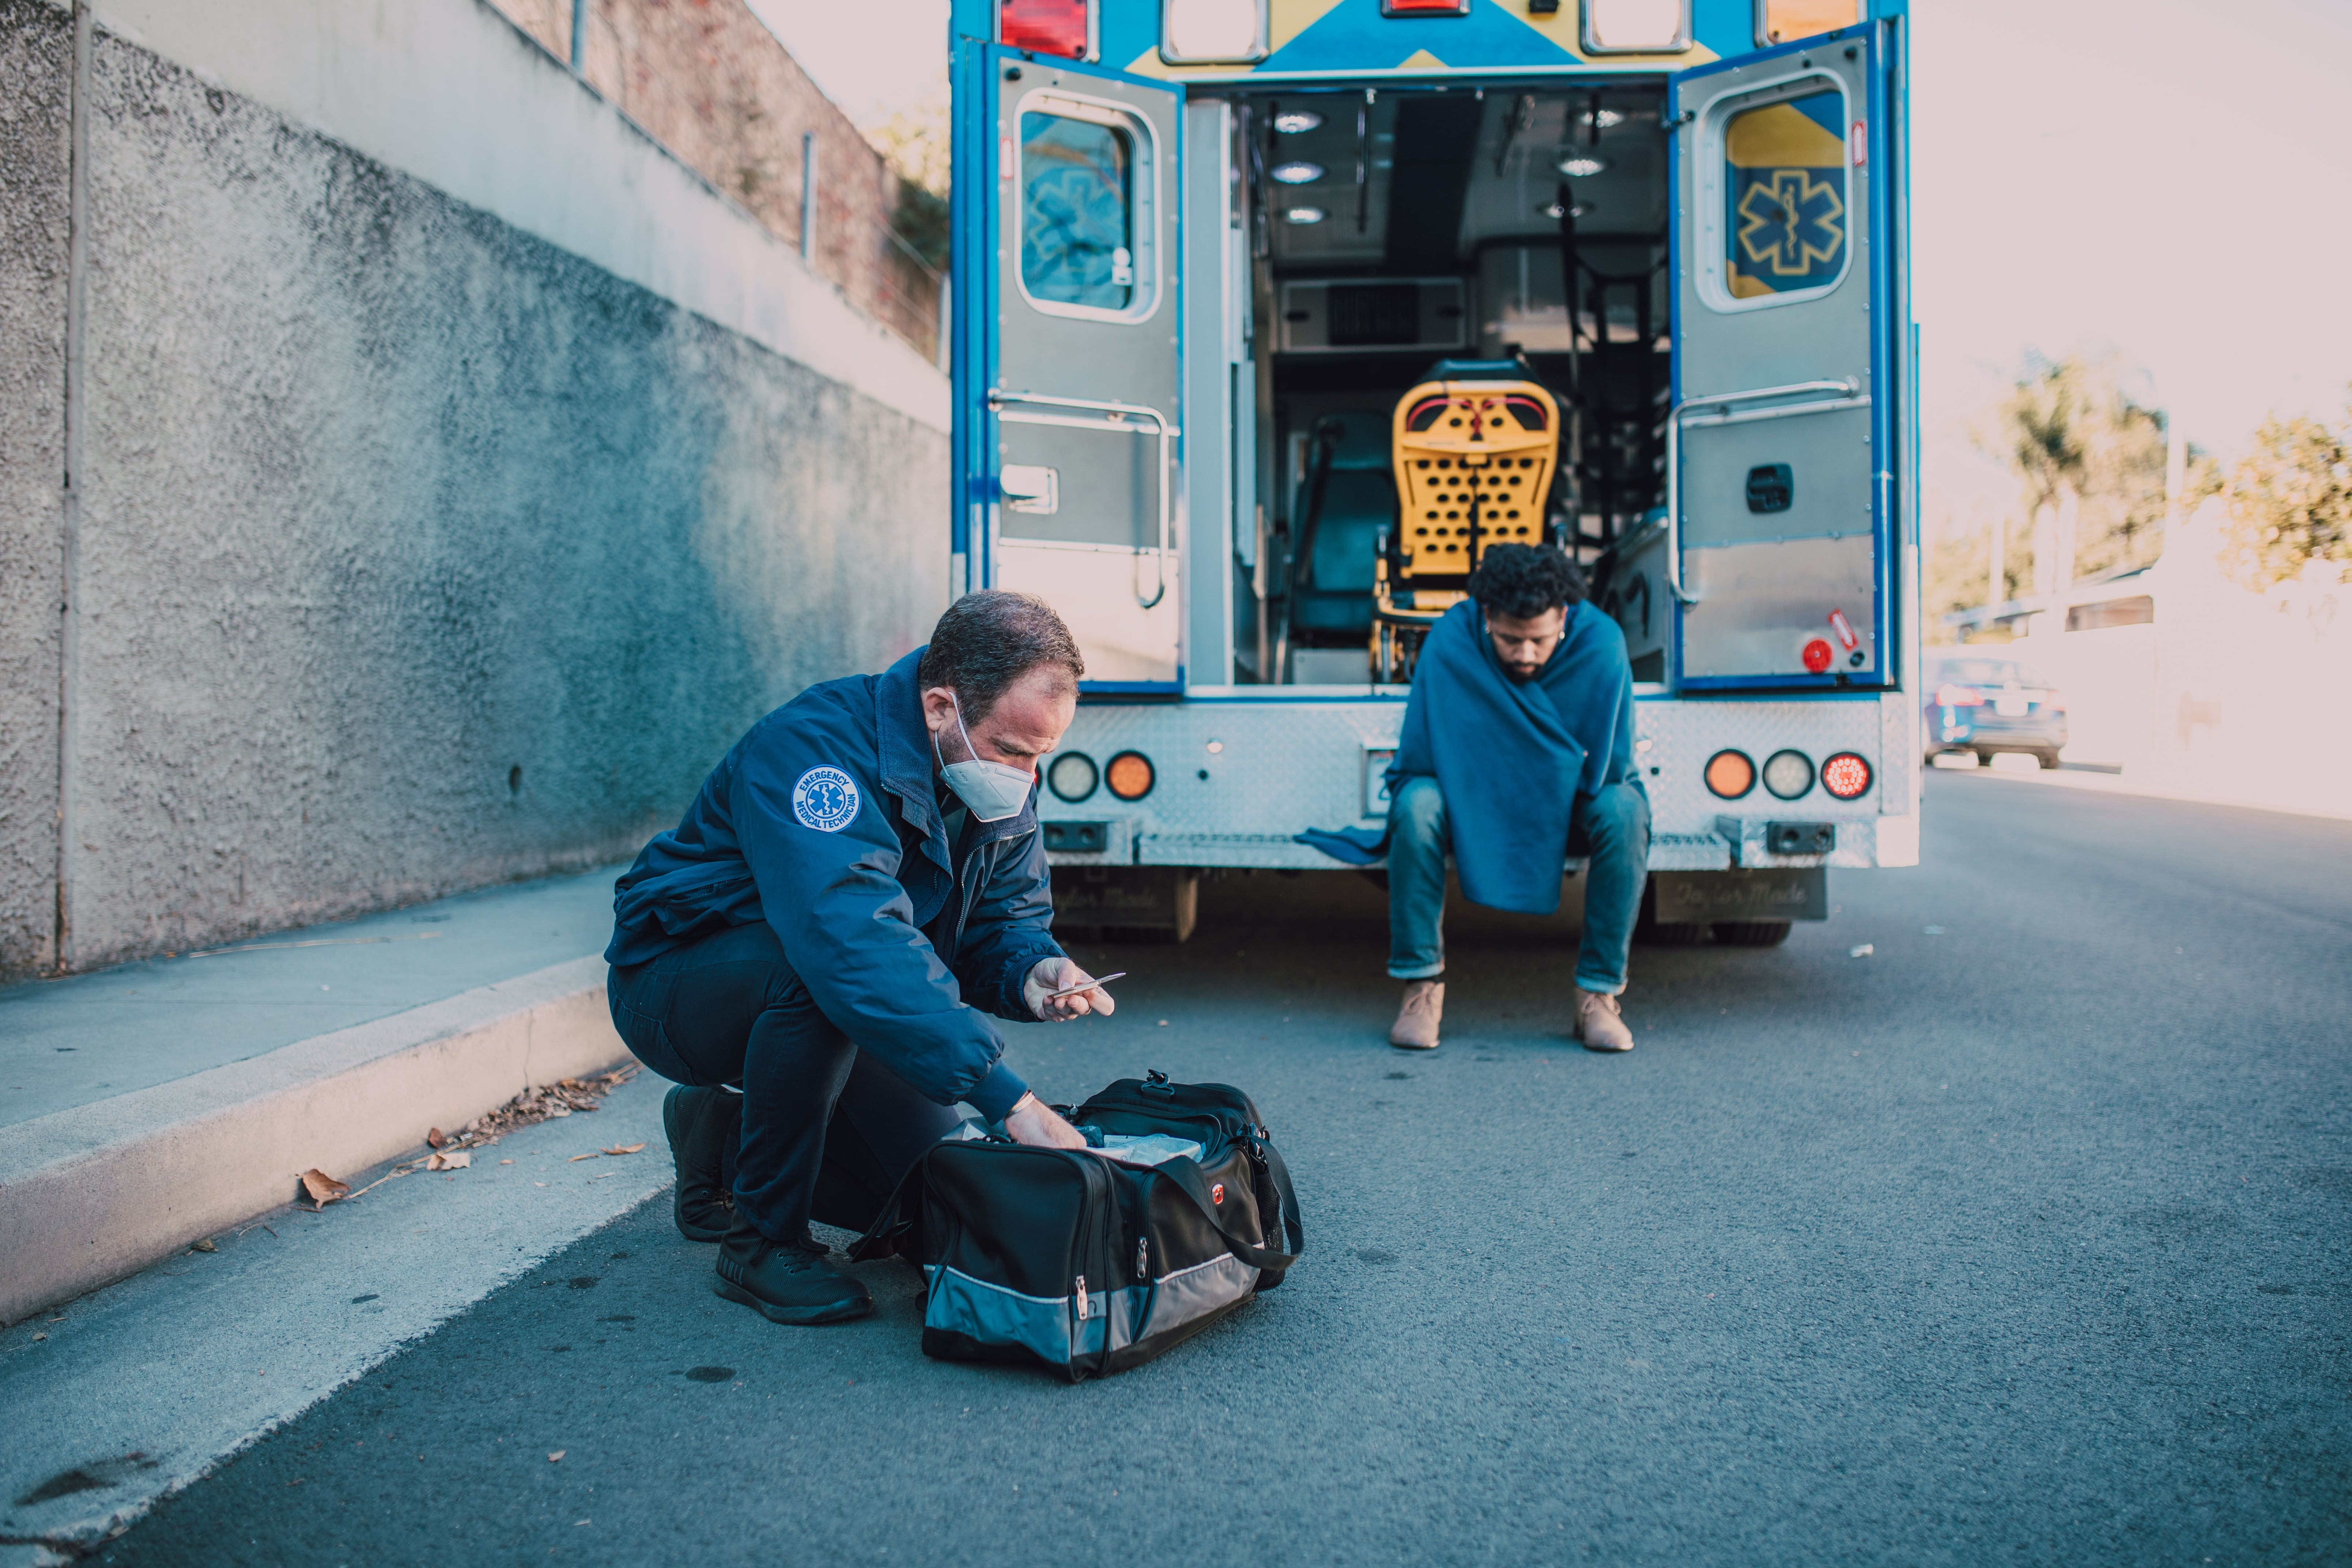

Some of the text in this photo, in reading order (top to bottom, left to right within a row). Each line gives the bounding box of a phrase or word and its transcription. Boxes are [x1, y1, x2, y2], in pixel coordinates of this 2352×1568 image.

[799, 771, 850, 791] EMERGENCY
[958, 771, 969, 782] KN95
[796, 794, 856, 829] MEDICAL TECHNICIAN
[1749, 880, 1807, 905] Made
